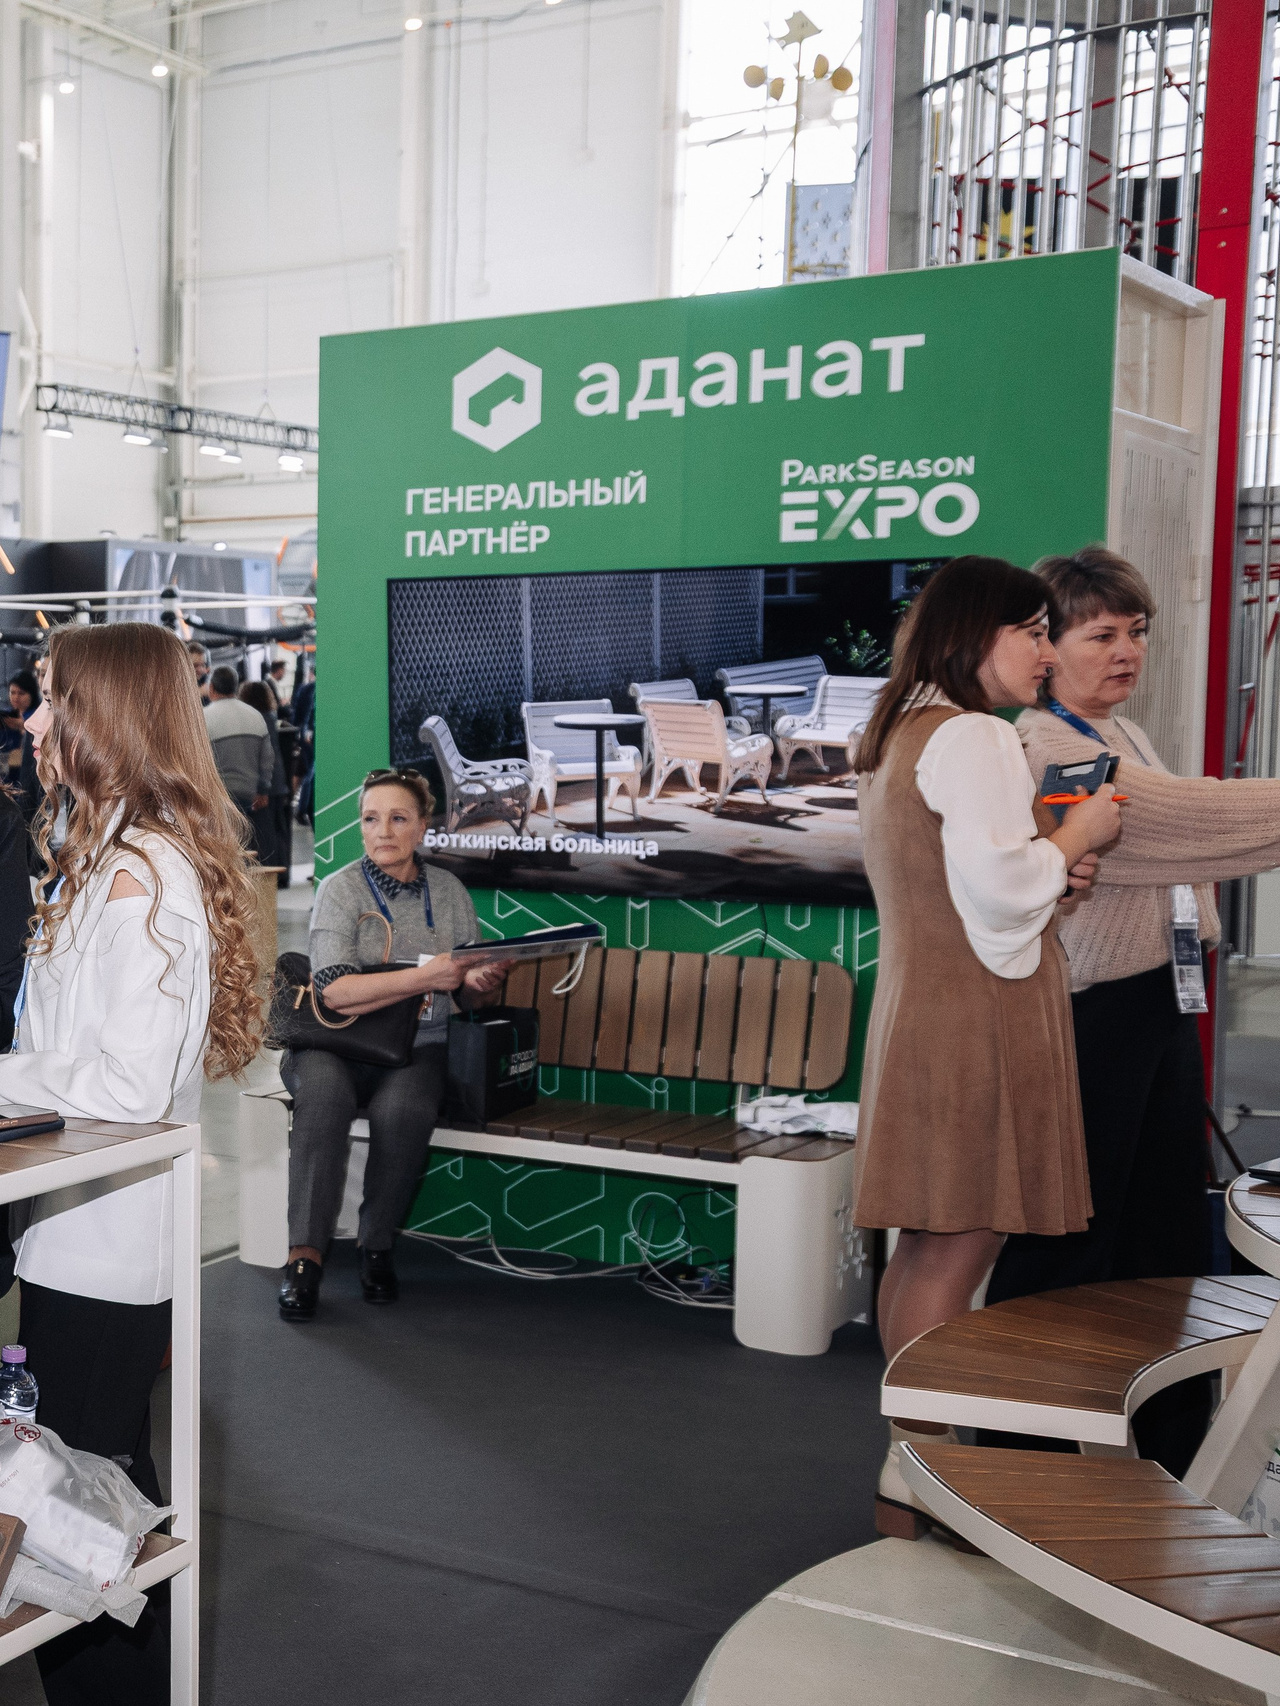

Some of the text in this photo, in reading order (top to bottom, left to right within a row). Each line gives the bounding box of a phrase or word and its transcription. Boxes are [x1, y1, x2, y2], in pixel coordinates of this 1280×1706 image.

[574, 333, 926, 421] аданат
[405, 470, 648, 515] ГЕНЕРАЛЬНЫЙ
[779, 482, 980, 543] EXPO
[405, 521, 551, 558] ПАРТНЁР
[423, 828, 660, 860] Боткинская больница
